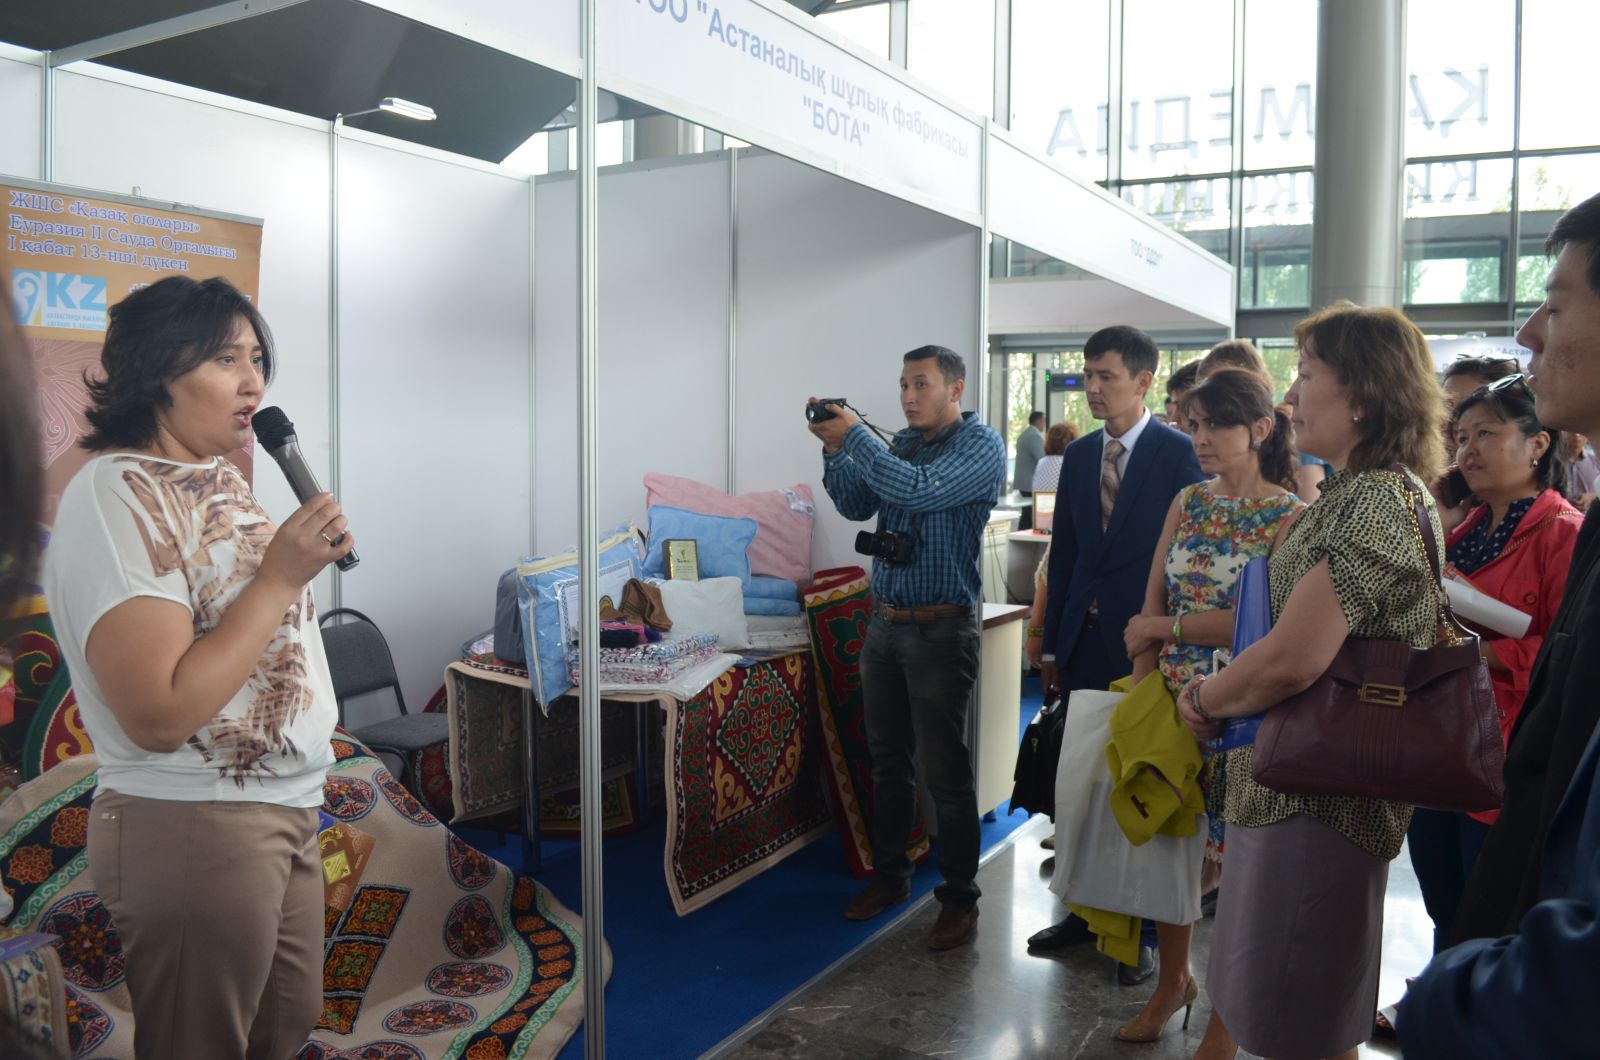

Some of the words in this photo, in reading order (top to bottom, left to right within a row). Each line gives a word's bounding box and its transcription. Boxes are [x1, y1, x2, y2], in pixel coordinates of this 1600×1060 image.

[696, 0, 827, 96] "Астаналық
[830, 73, 889, 123] шұлық
[892, 102, 970, 160] фабрикасы
[802, 95, 870, 147] "БОТА"
[9, 190, 64, 213] ЖШС
[68, 199, 129, 225] «Қазақ
[132, 212, 201, 235] оюлары»
[9, 213, 86, 237] Еуразия
[107, 227, 157, 249] Сауда
[160, 235, 238, 260] Орталығы
[20, 239, 76, 256] қабат
[81, 243, 138, 265] 13-нші
[142, 254, 190, 272] дүкен
[47, 270, 107, 311] KZ
